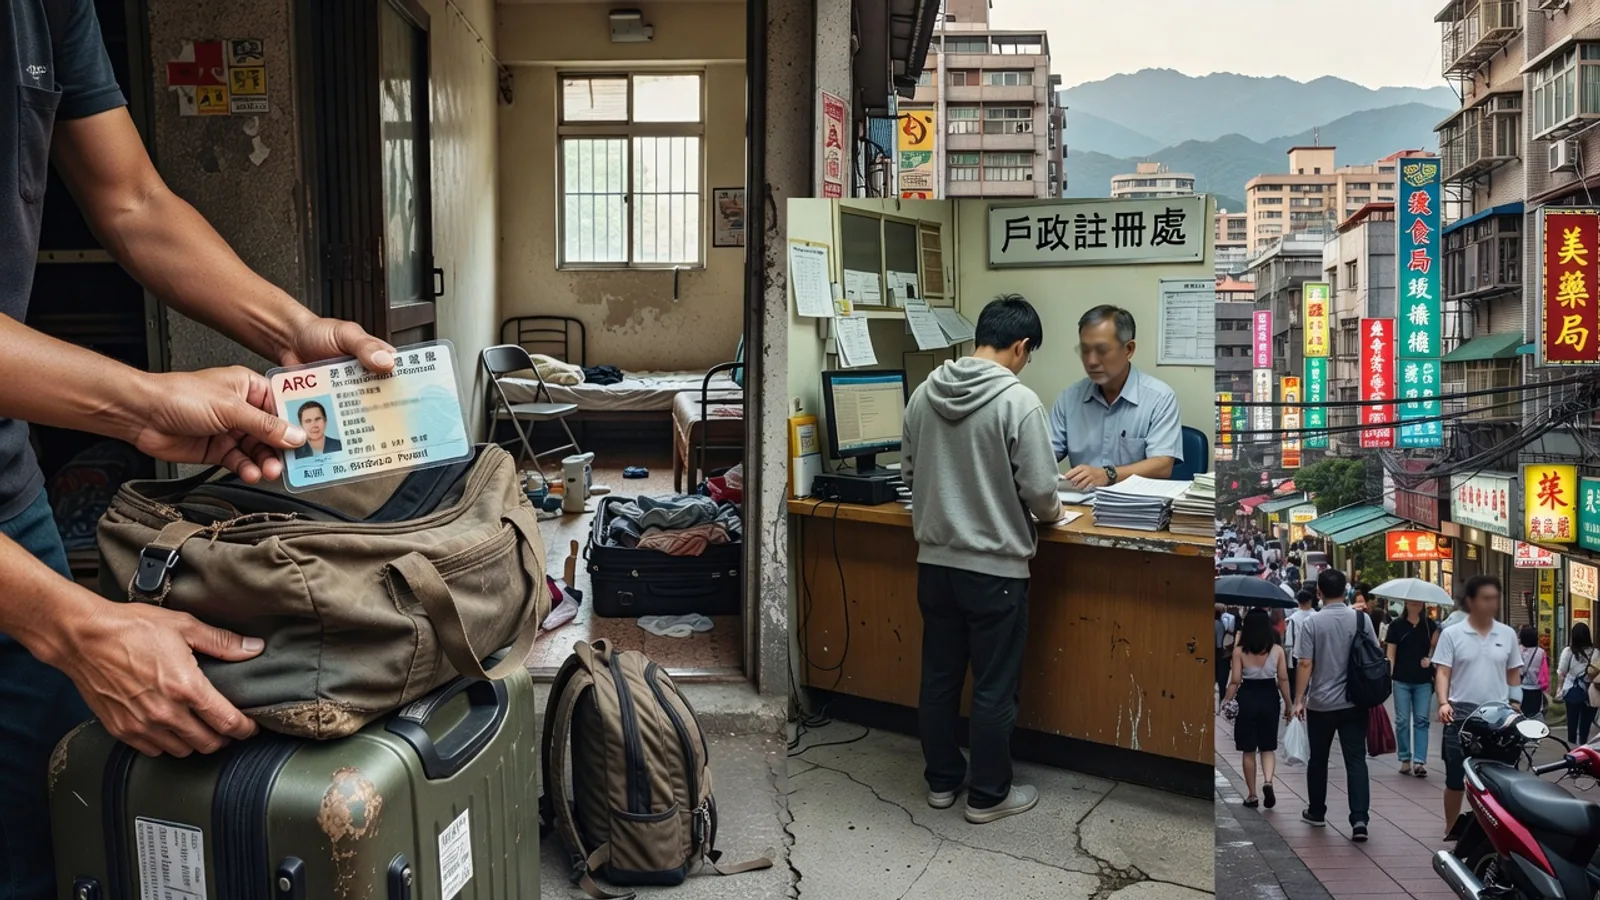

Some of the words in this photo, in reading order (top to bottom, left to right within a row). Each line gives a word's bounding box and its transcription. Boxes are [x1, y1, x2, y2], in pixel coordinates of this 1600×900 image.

[1001, 207, 1186, 253] 戶政註冊處
[1553, 225, 1590, 353] 美藥局
[282, 374, 317, 393] ARC
